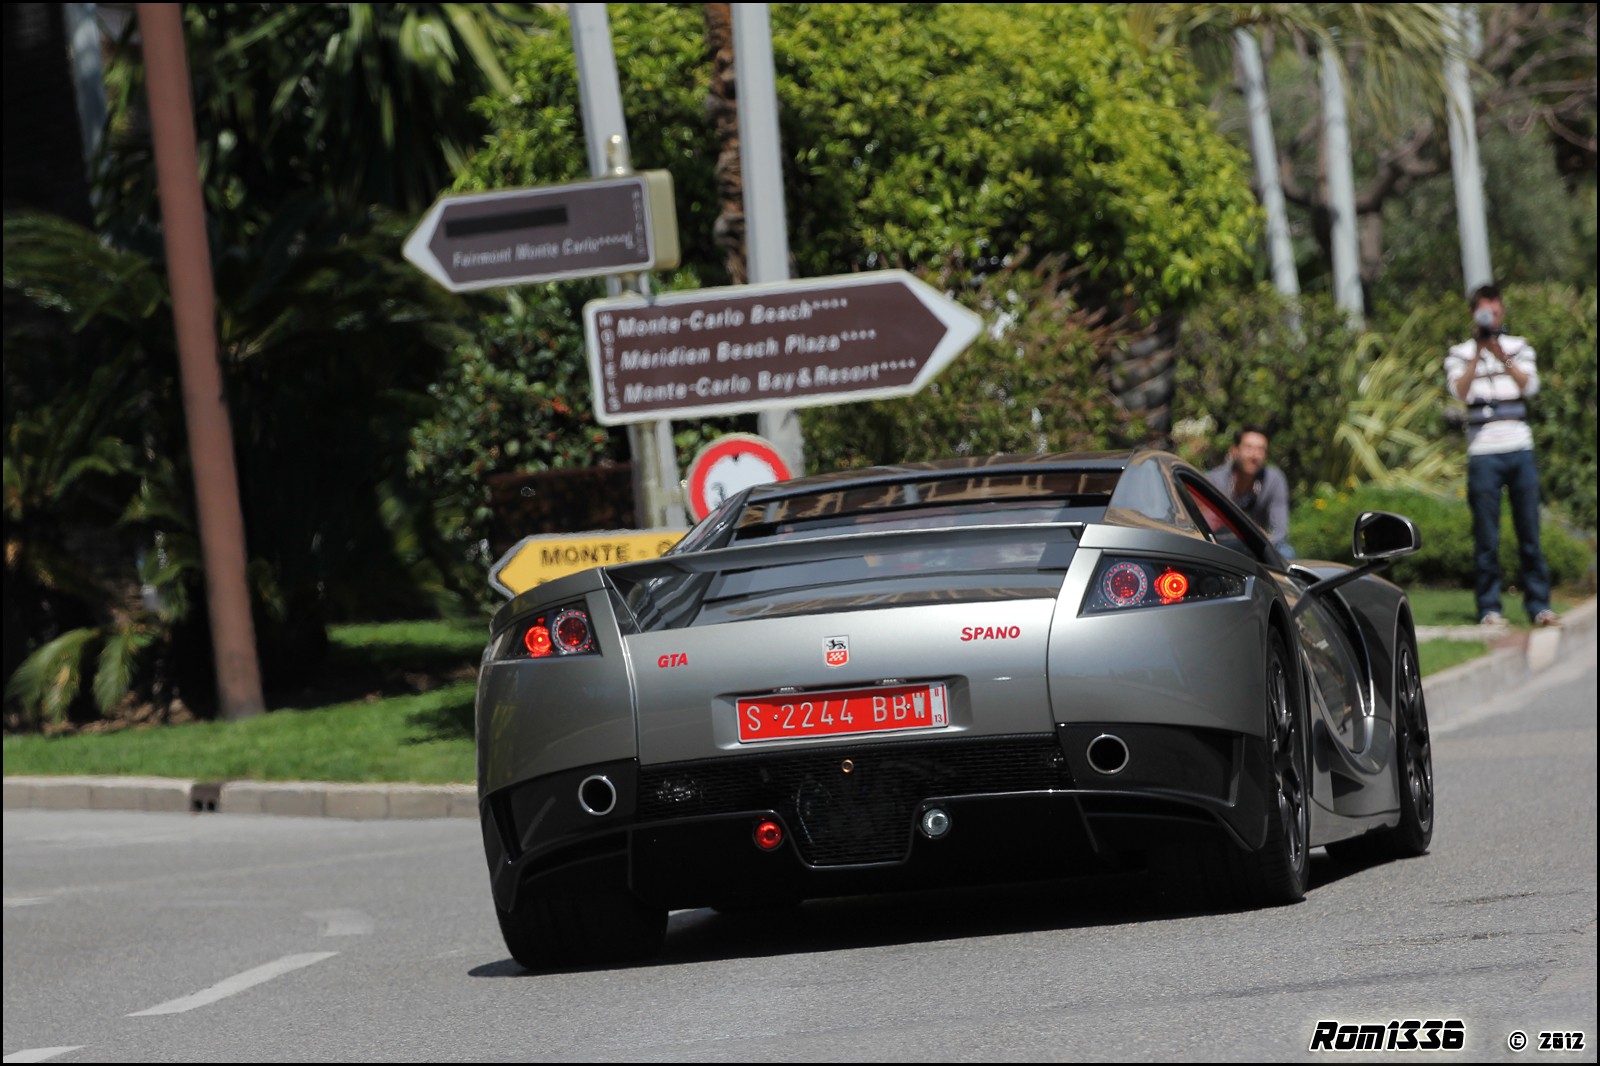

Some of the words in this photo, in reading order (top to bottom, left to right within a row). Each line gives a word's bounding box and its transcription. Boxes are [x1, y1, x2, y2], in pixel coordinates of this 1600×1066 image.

[453, 247, 512, 268] Fairmont
[515, 241, 559, 262] Monte
[616, 307, 745, 338] Monte-Carlo
[599, 312, 621, 411] HOTELS
[716, 336, 779, 362] Beach
[623, 372, 751, 404] Monte-Carlo
[541, 542, 631, 567] MONTE
[960, 625, 1021, 641] SPANO
[657, 652, 688, 669] GTA
[746, 705, 761, 732] S
[781, 698, 854, 729] 2244
[934, 714, 943, 723] 13
